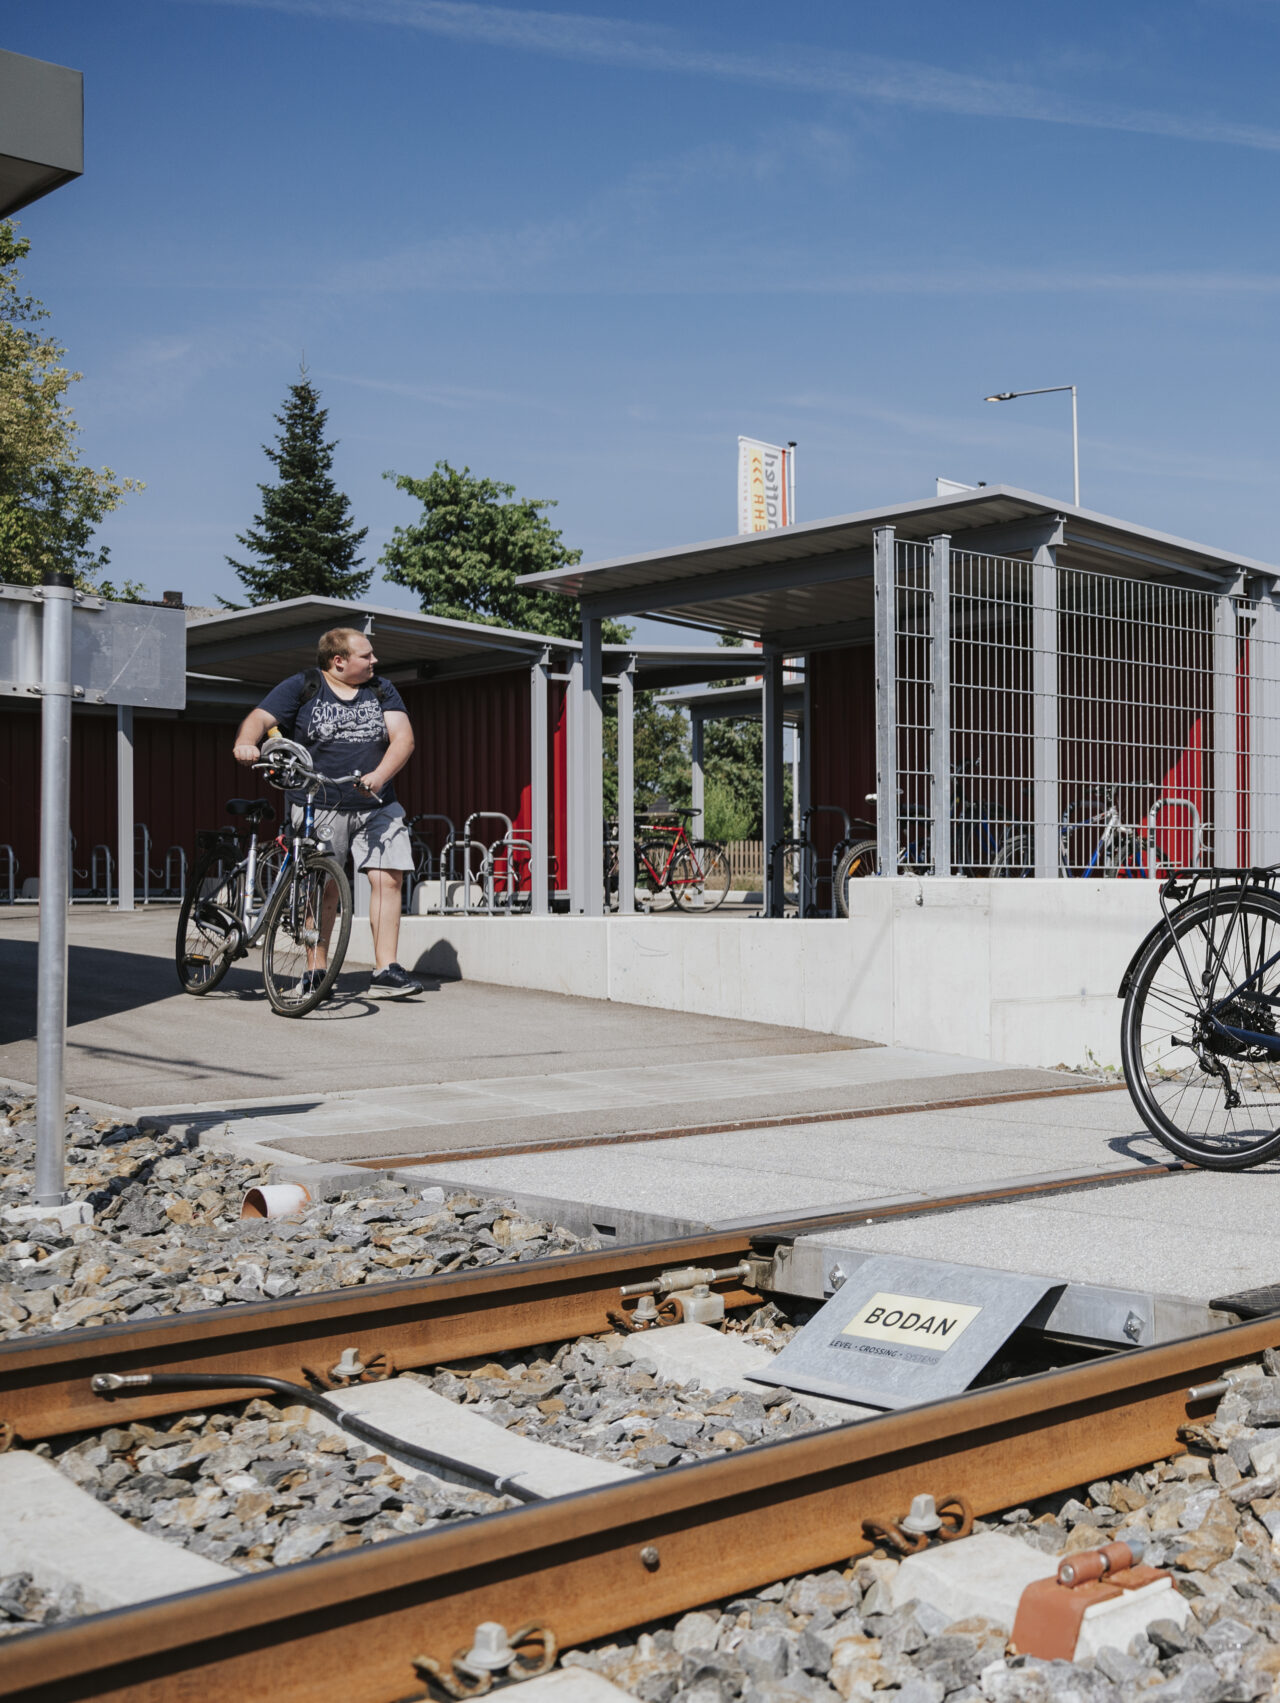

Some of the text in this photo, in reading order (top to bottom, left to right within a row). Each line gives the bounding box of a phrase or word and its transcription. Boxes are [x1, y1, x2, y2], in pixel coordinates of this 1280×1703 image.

[864, 1307, 957, 1336] BODAN
[829, 1339, 940, 1364] LEVEL CROSSING SYSTEMS
